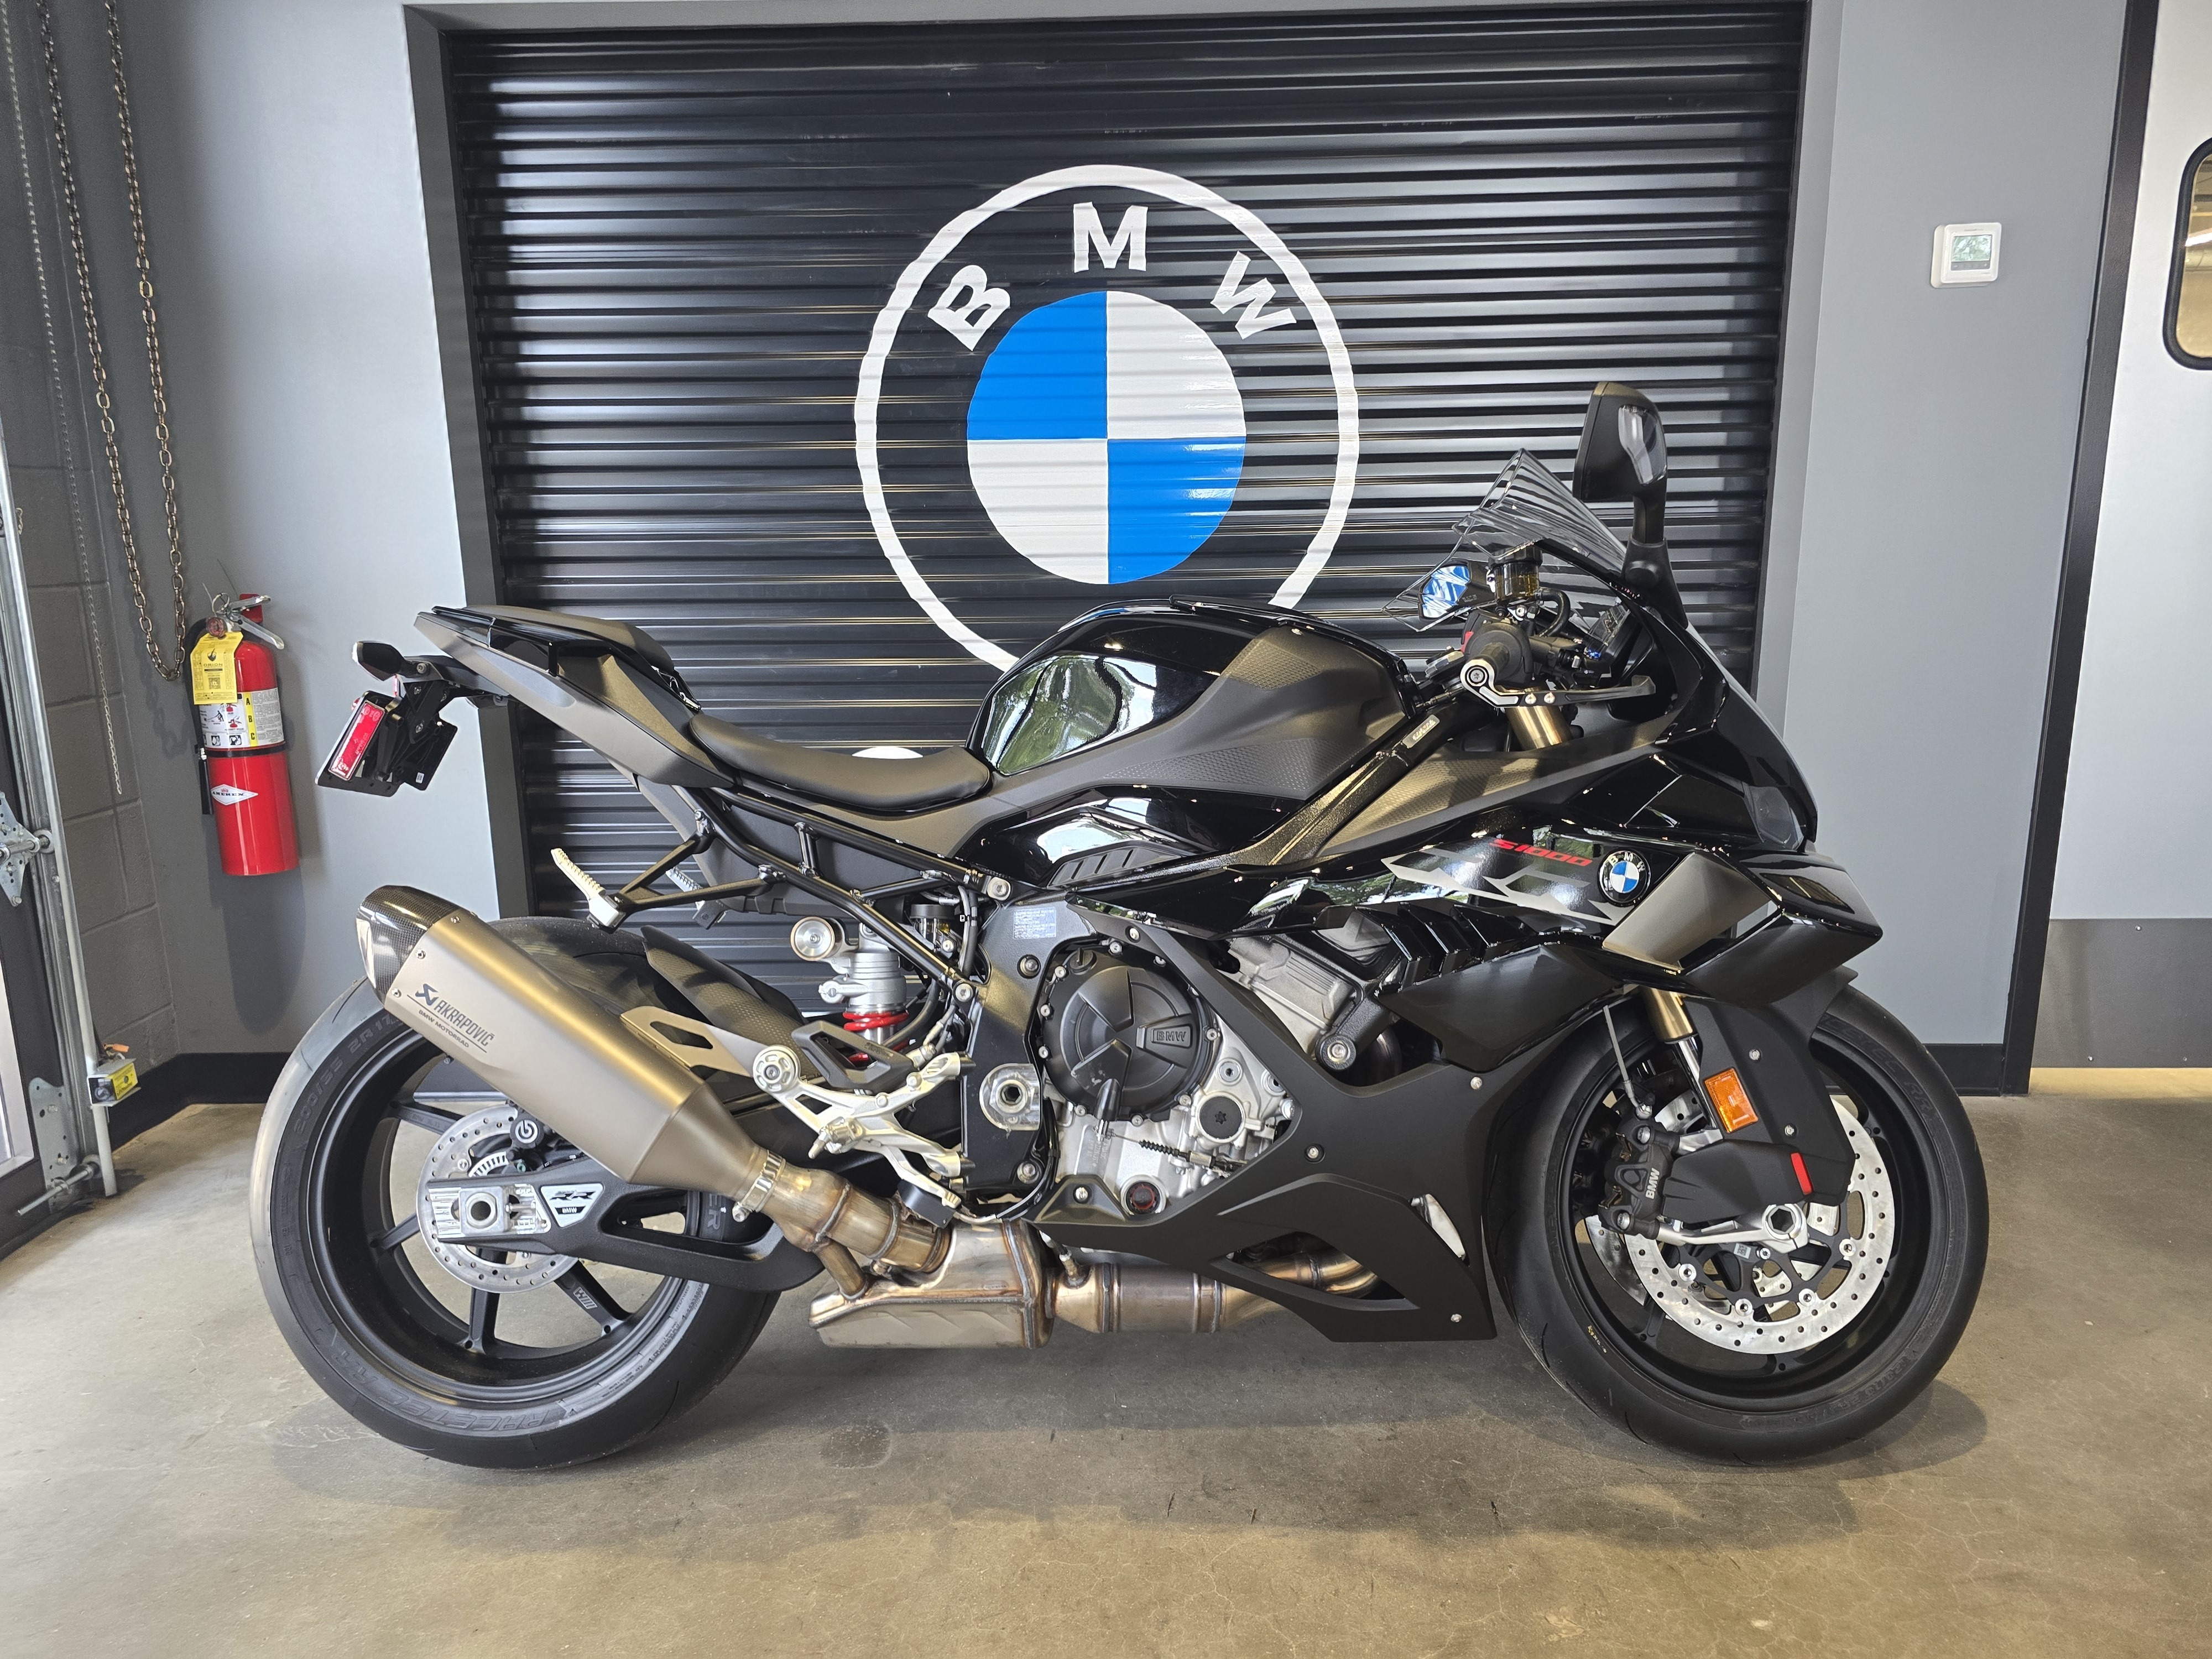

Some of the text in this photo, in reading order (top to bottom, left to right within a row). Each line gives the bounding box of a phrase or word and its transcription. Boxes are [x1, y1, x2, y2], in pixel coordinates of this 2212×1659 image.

[928, 202, 1297, 351] BMW
[1489, 838, 1593, 867] S1000
[1608, 852, 1646, 872] BMW
[418, 1009, 469, 1048] BMW MOTORRAD
[1155, 1030, 1187, 1042] BMW
[1645, 1167, 1661, 1199] BMW
[377, 1387, 549, 1432] RACETEC
